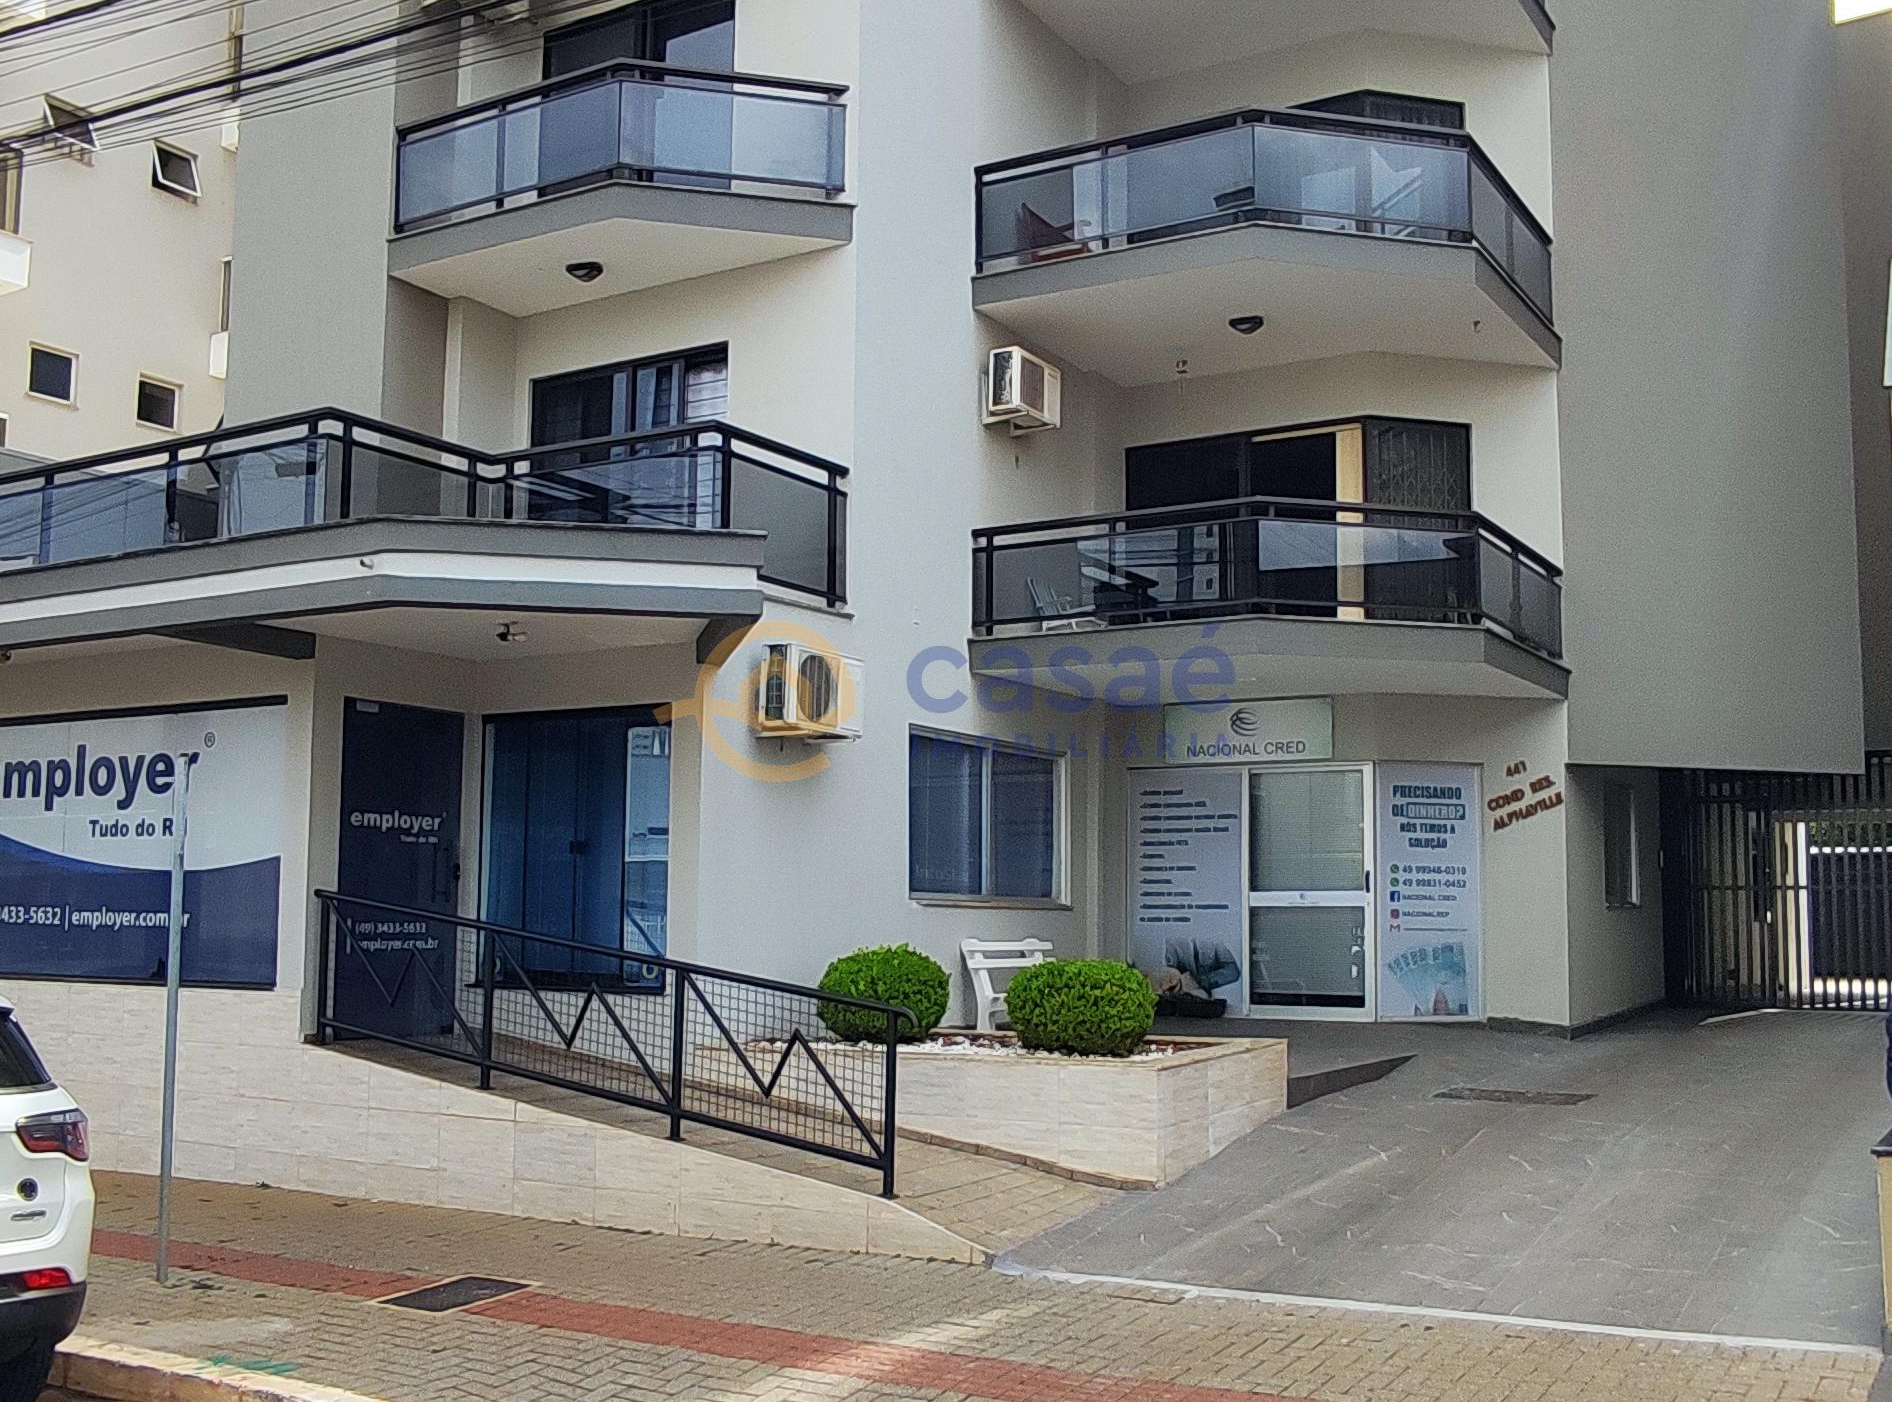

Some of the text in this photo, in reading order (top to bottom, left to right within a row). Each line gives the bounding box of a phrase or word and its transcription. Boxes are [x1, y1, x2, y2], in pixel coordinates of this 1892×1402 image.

[1186, 740, 1307, 758] NACIONAL CRED
[0, 744, 201, 812] mploye
[1392, 785, 1462, 800] PRECISANDO
[1392, 803, 1405, 817] DE
[1493, 791, 1564, 832] ALPHAVILLE
[88, 817, 188, 838] Tudo do R
[350, 809, 443, 834] employer
[1449, 823, 1456, 835] A
[1407, 836, 1448, 850] SOLUÇÃO
[0, 905, 61, 925] 433-5632
[71, 905, 191, 931] employer.comr
